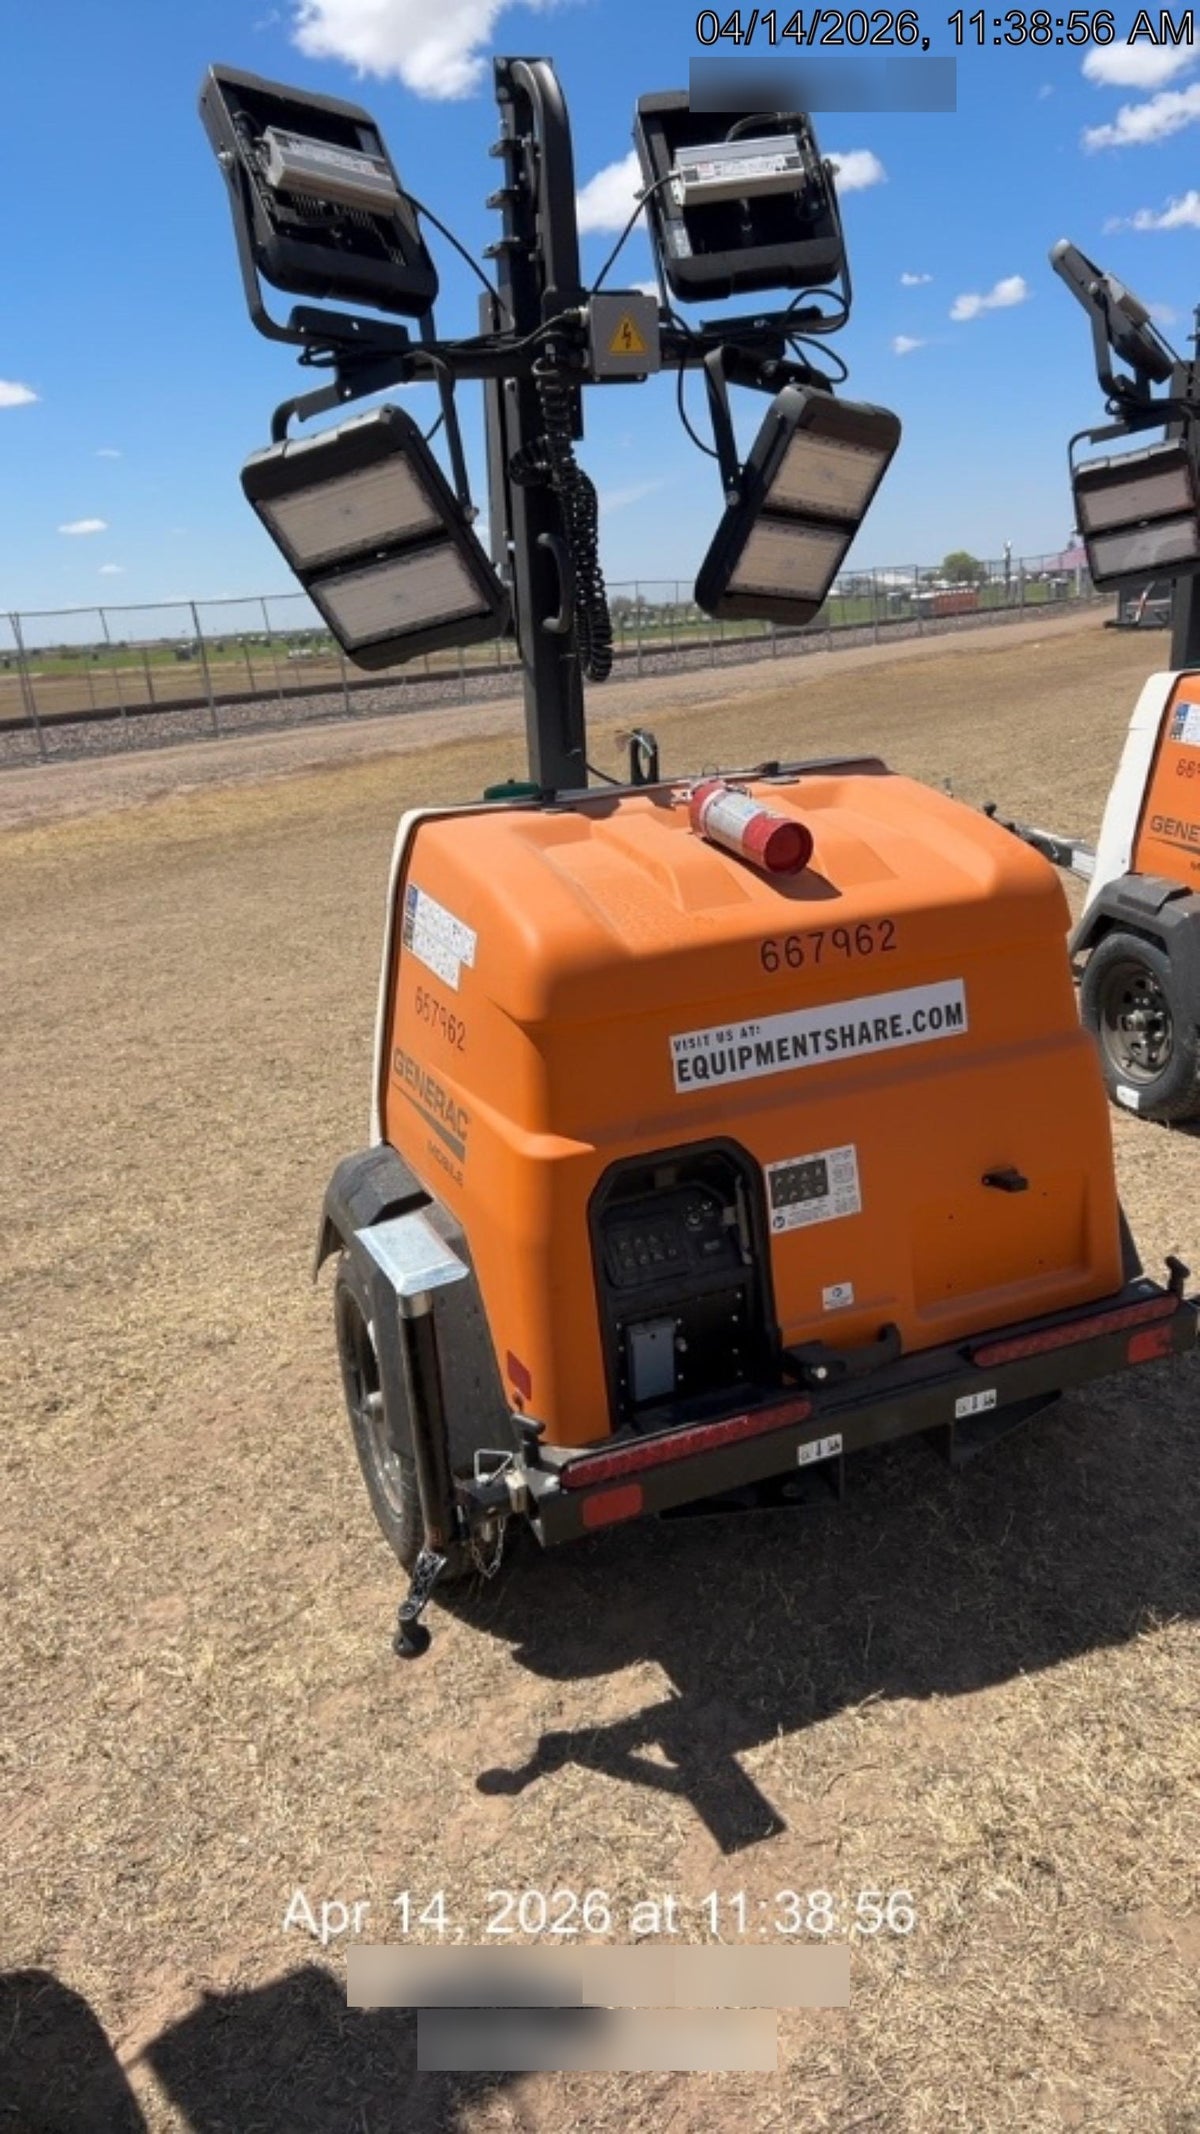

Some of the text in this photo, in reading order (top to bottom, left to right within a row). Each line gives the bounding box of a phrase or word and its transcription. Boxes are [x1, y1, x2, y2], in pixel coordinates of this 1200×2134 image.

[761, 919, 897, 972] 667962
[414, 986, 466, 1051] 667962
[674, 1024, 760, 1051] VISIT US AT:
[677, 1002, 963, 1082] EQUIPMENTSHARE.COM
[393, 1047, 470, 1141] GENERAC
